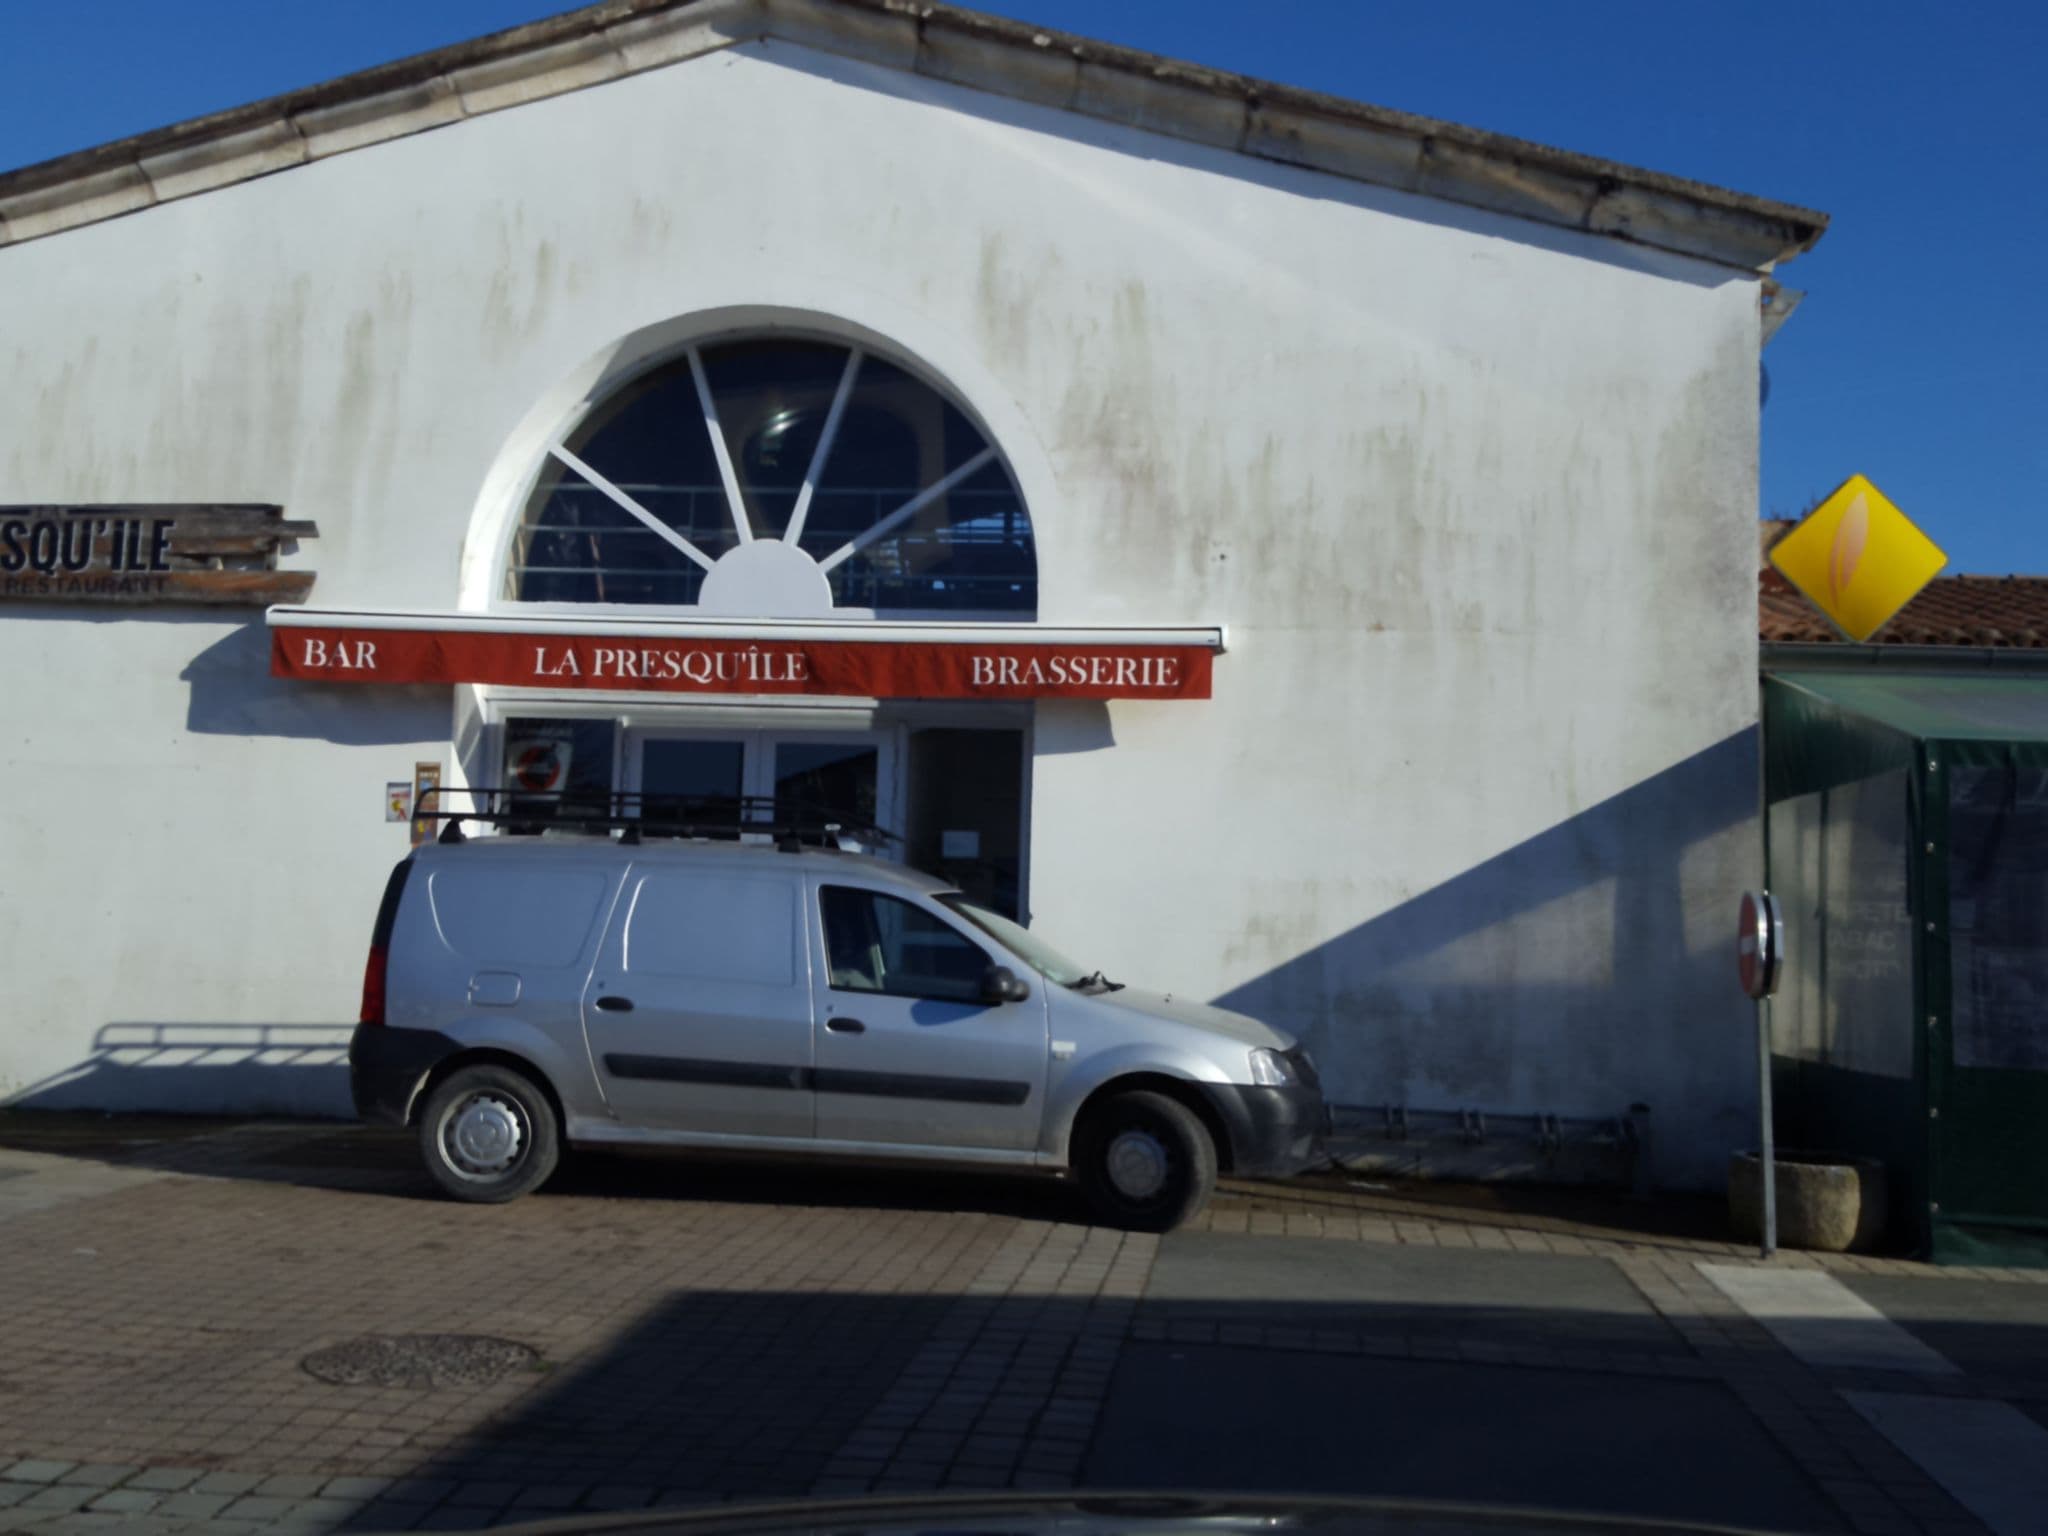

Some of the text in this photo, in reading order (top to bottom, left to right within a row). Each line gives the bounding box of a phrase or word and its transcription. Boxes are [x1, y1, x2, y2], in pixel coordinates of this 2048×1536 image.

[5, 576, 168, 593] RESTAURANT
[303, 639, 1180, 686] BAR LA PRESQU'ÎLE BRASSERIE
